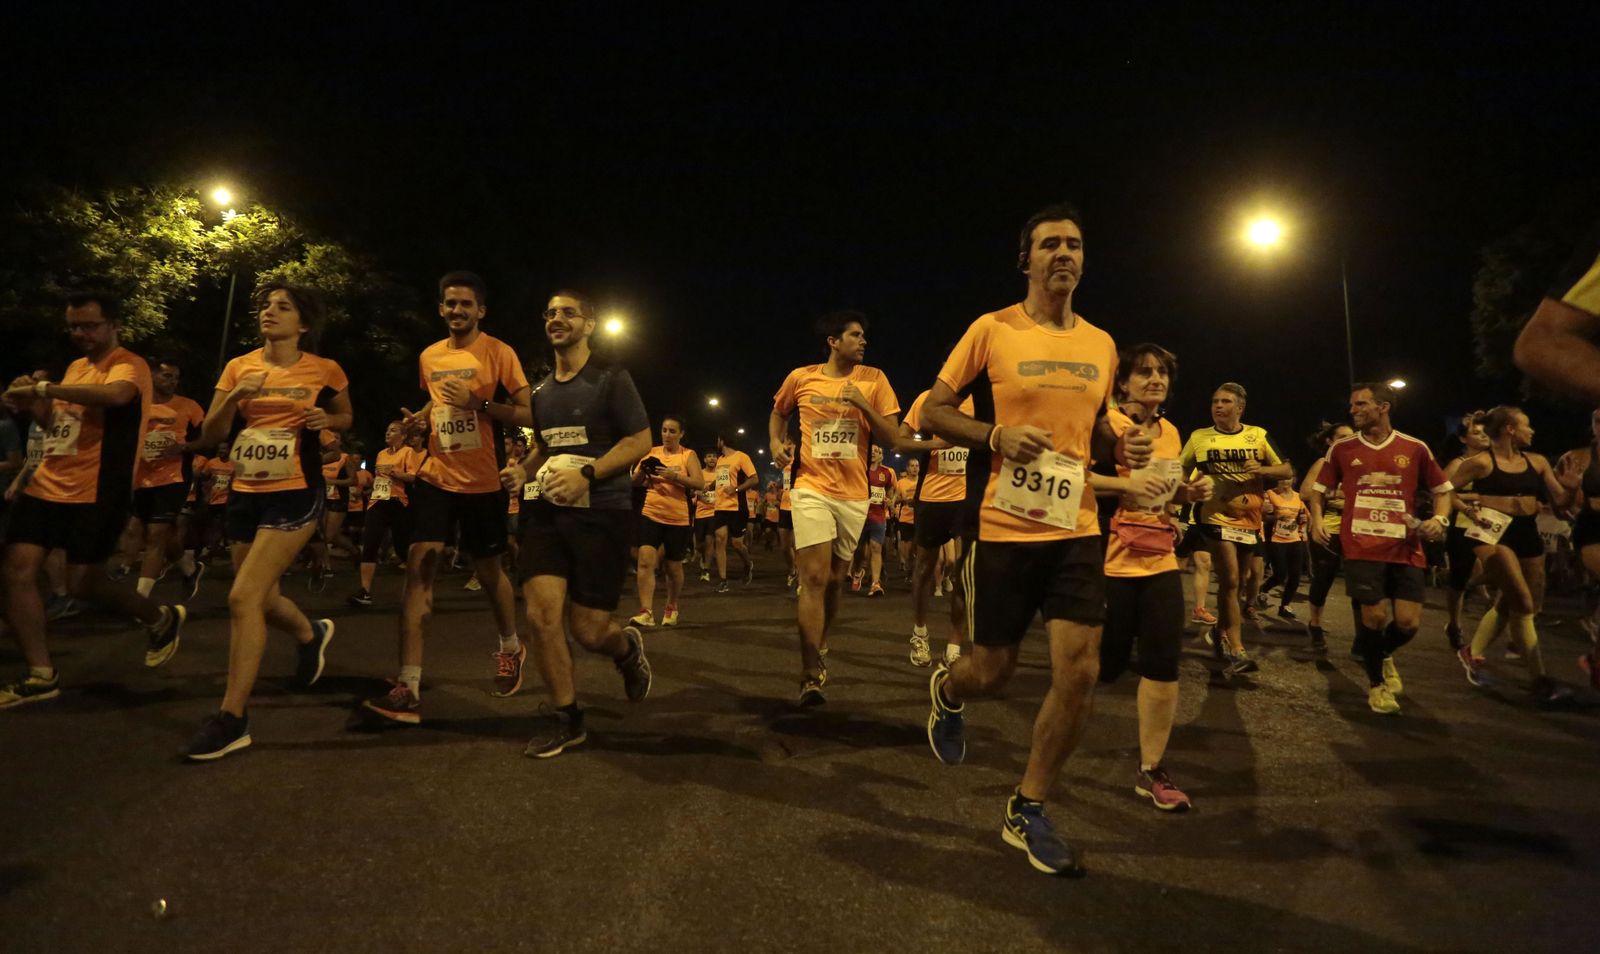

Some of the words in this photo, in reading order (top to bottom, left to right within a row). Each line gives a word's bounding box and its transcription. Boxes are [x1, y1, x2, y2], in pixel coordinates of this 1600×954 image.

[46, 424, 71, 438] 66
[814, 431, 855, 443] 15527
[234, 445, 289, 460] 14094
[1011, 467, 1071, 500] 9316
[1369, 509, 1389, 523] 66
